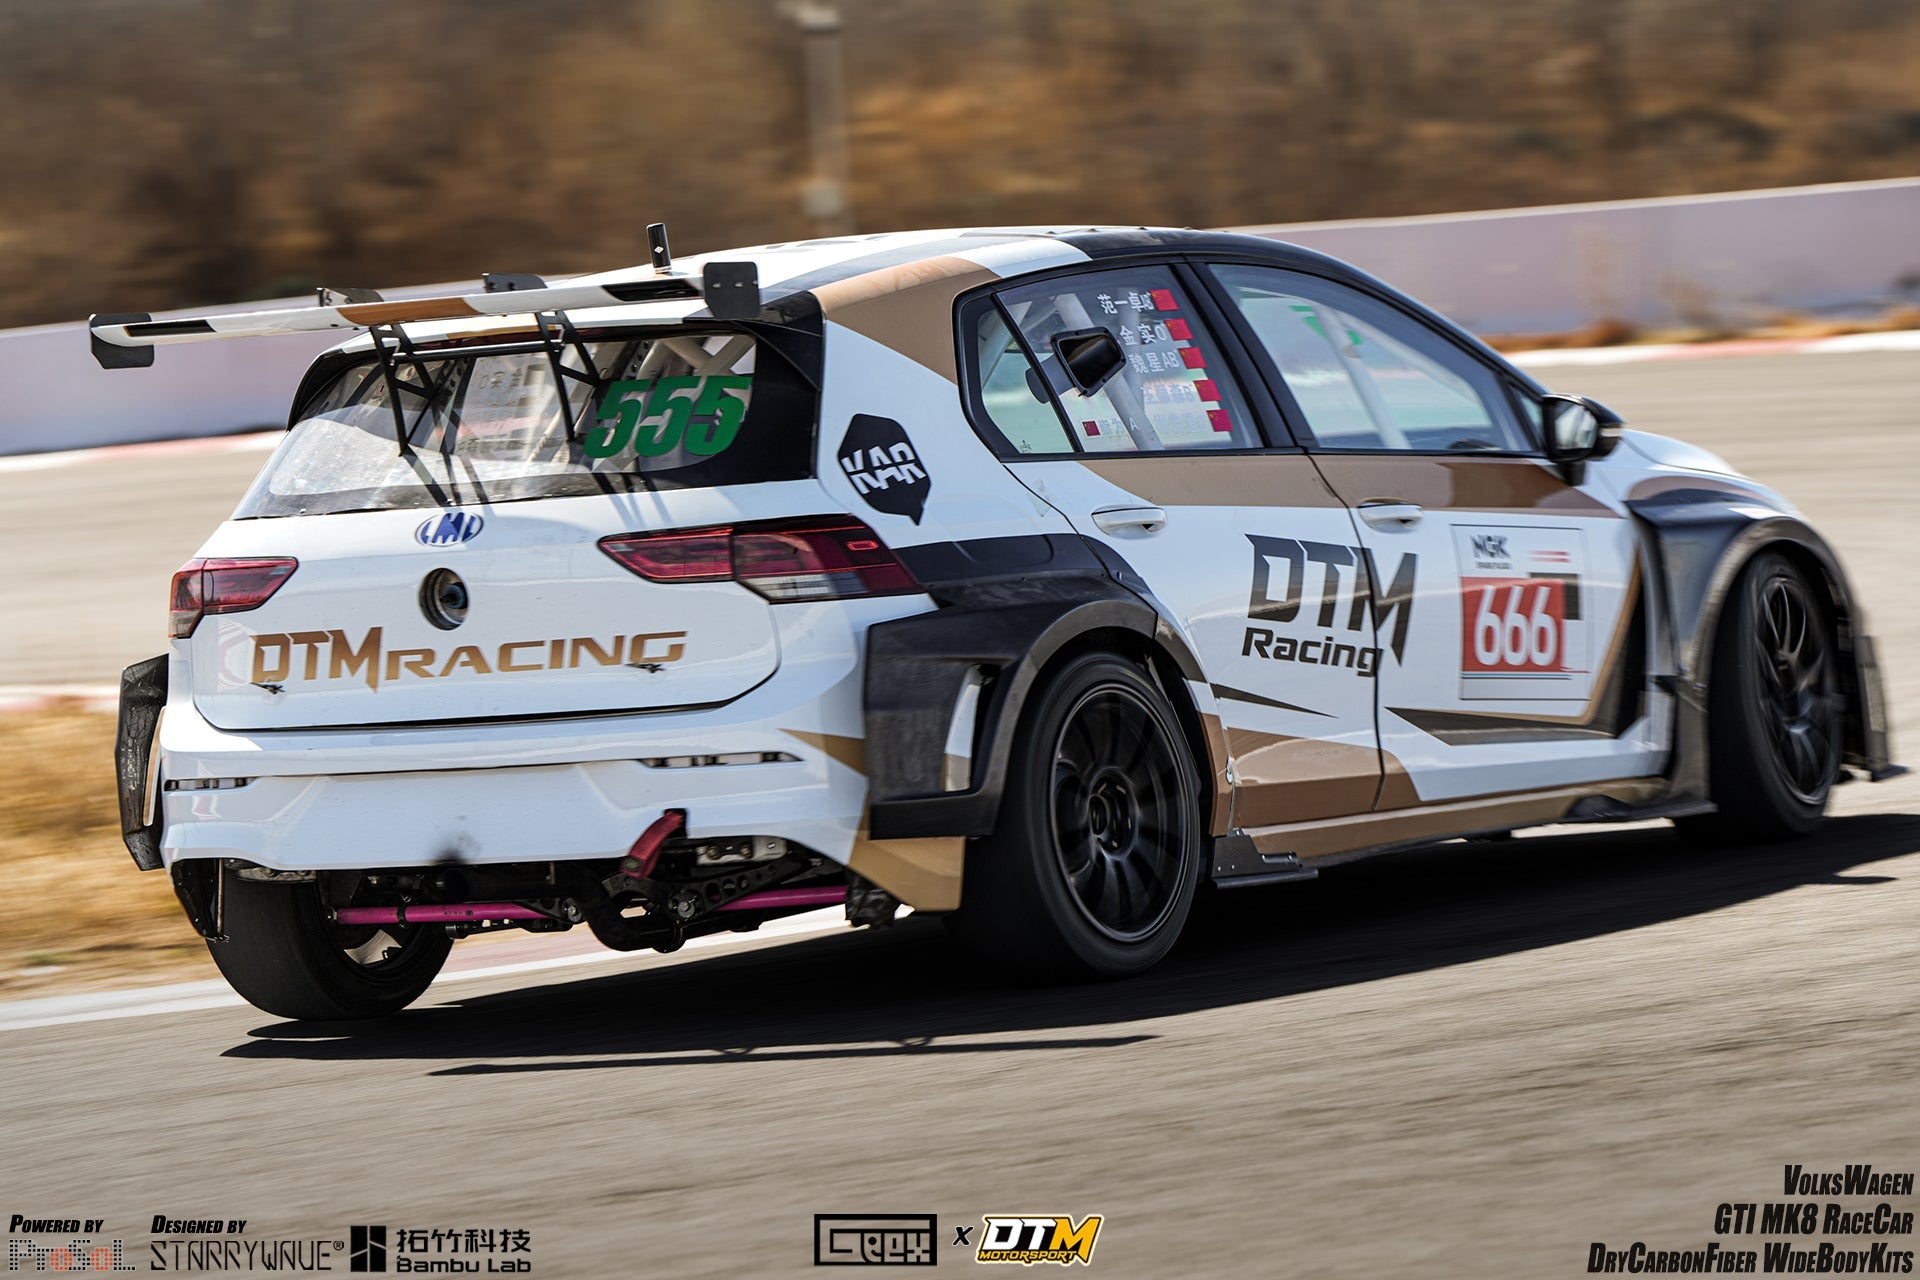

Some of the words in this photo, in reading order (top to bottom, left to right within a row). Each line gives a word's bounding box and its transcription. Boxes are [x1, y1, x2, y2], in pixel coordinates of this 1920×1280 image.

[583, 375, 754, 459] 555
[841, 442, 927, 495] KAR
[1244, 533, 1418, 668] DTM
[1474, 585, 1558, 666] 666
[250, 626, 384, 694] DTM
[384, 631, 688, 681] RACING
[1241, 626, 1384, 678] Racing
